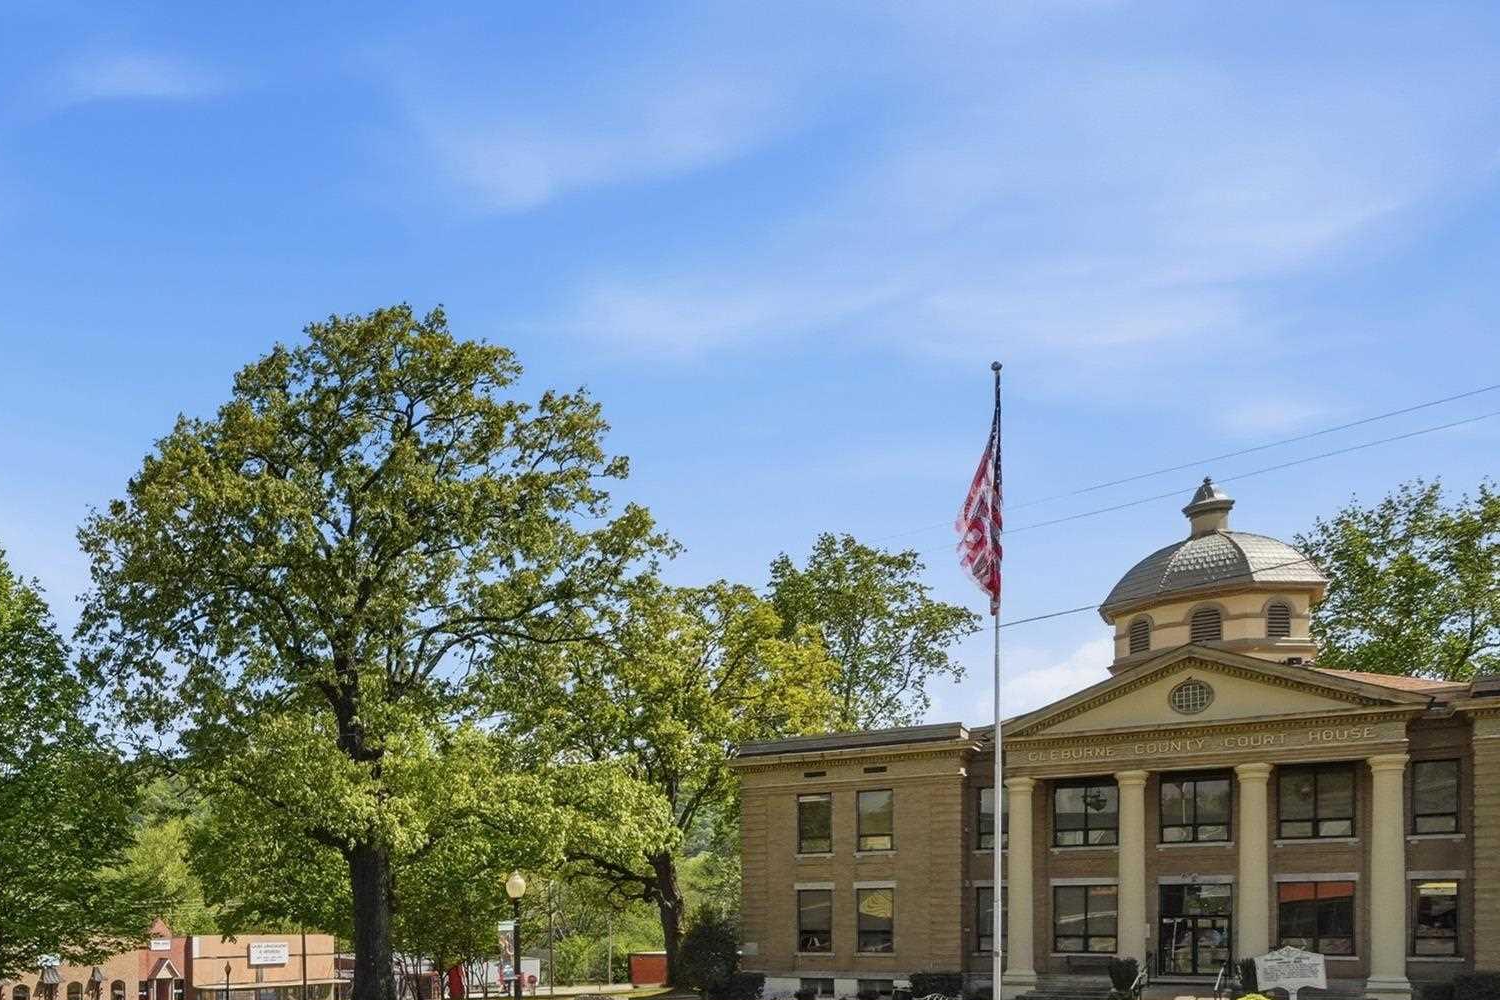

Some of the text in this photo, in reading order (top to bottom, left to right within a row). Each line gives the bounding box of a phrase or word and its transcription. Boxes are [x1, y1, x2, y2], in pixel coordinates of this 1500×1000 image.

[1028, 727, 1377, 762] CLEBURNE COUNTY COURT HOUSE
